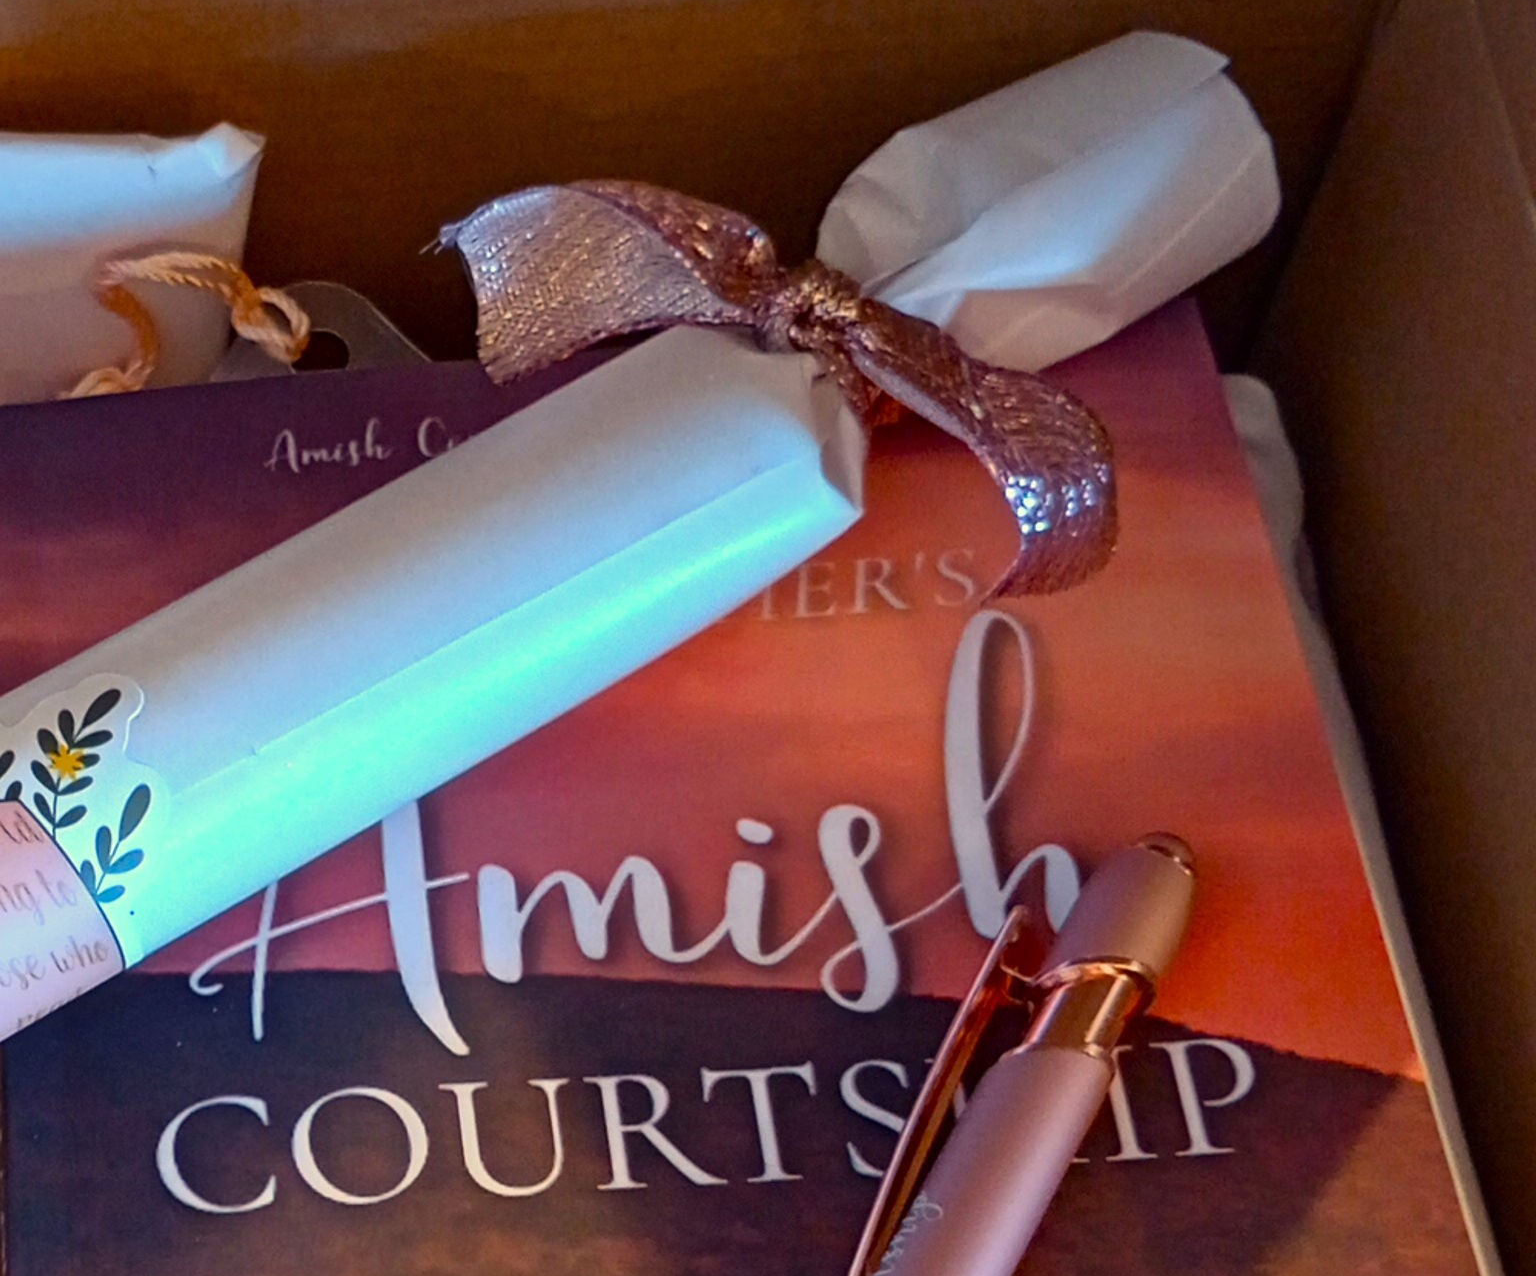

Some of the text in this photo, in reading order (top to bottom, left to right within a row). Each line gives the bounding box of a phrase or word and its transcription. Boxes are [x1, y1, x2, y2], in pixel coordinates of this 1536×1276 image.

[263, 417, 394, 473] Amish
[189, 609, 1080, 1056] Amish
[34, 868, 80, 908] to
[49, 934, 112, 975] who
[155, 1037, 1256, 1214] COURTSIP
